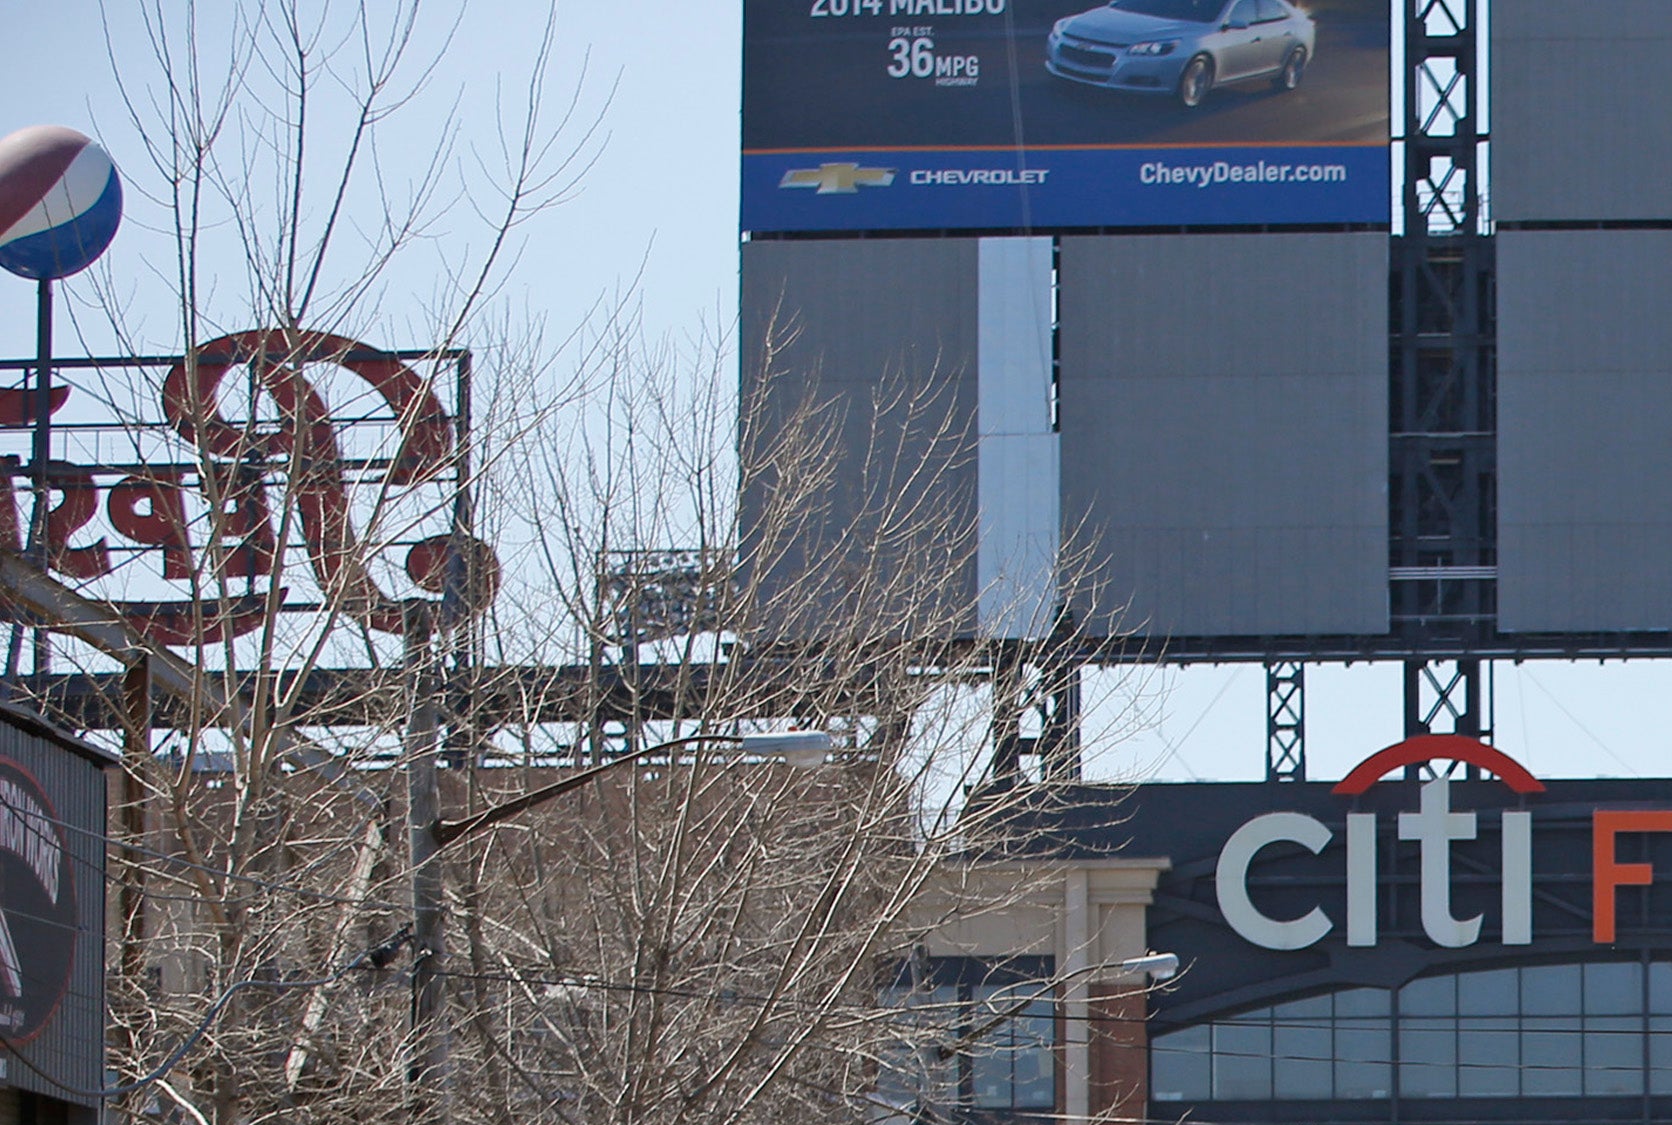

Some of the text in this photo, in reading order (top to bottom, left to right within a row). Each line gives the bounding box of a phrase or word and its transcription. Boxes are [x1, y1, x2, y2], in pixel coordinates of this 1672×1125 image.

[890, 26, 911, 37] EPA
[887, 37, 979, 78] 36 MPG
[910, 161, 1347, 187] CHEVROLET ChevyDealer.com
[1216, 775, 1531, 951] citi
